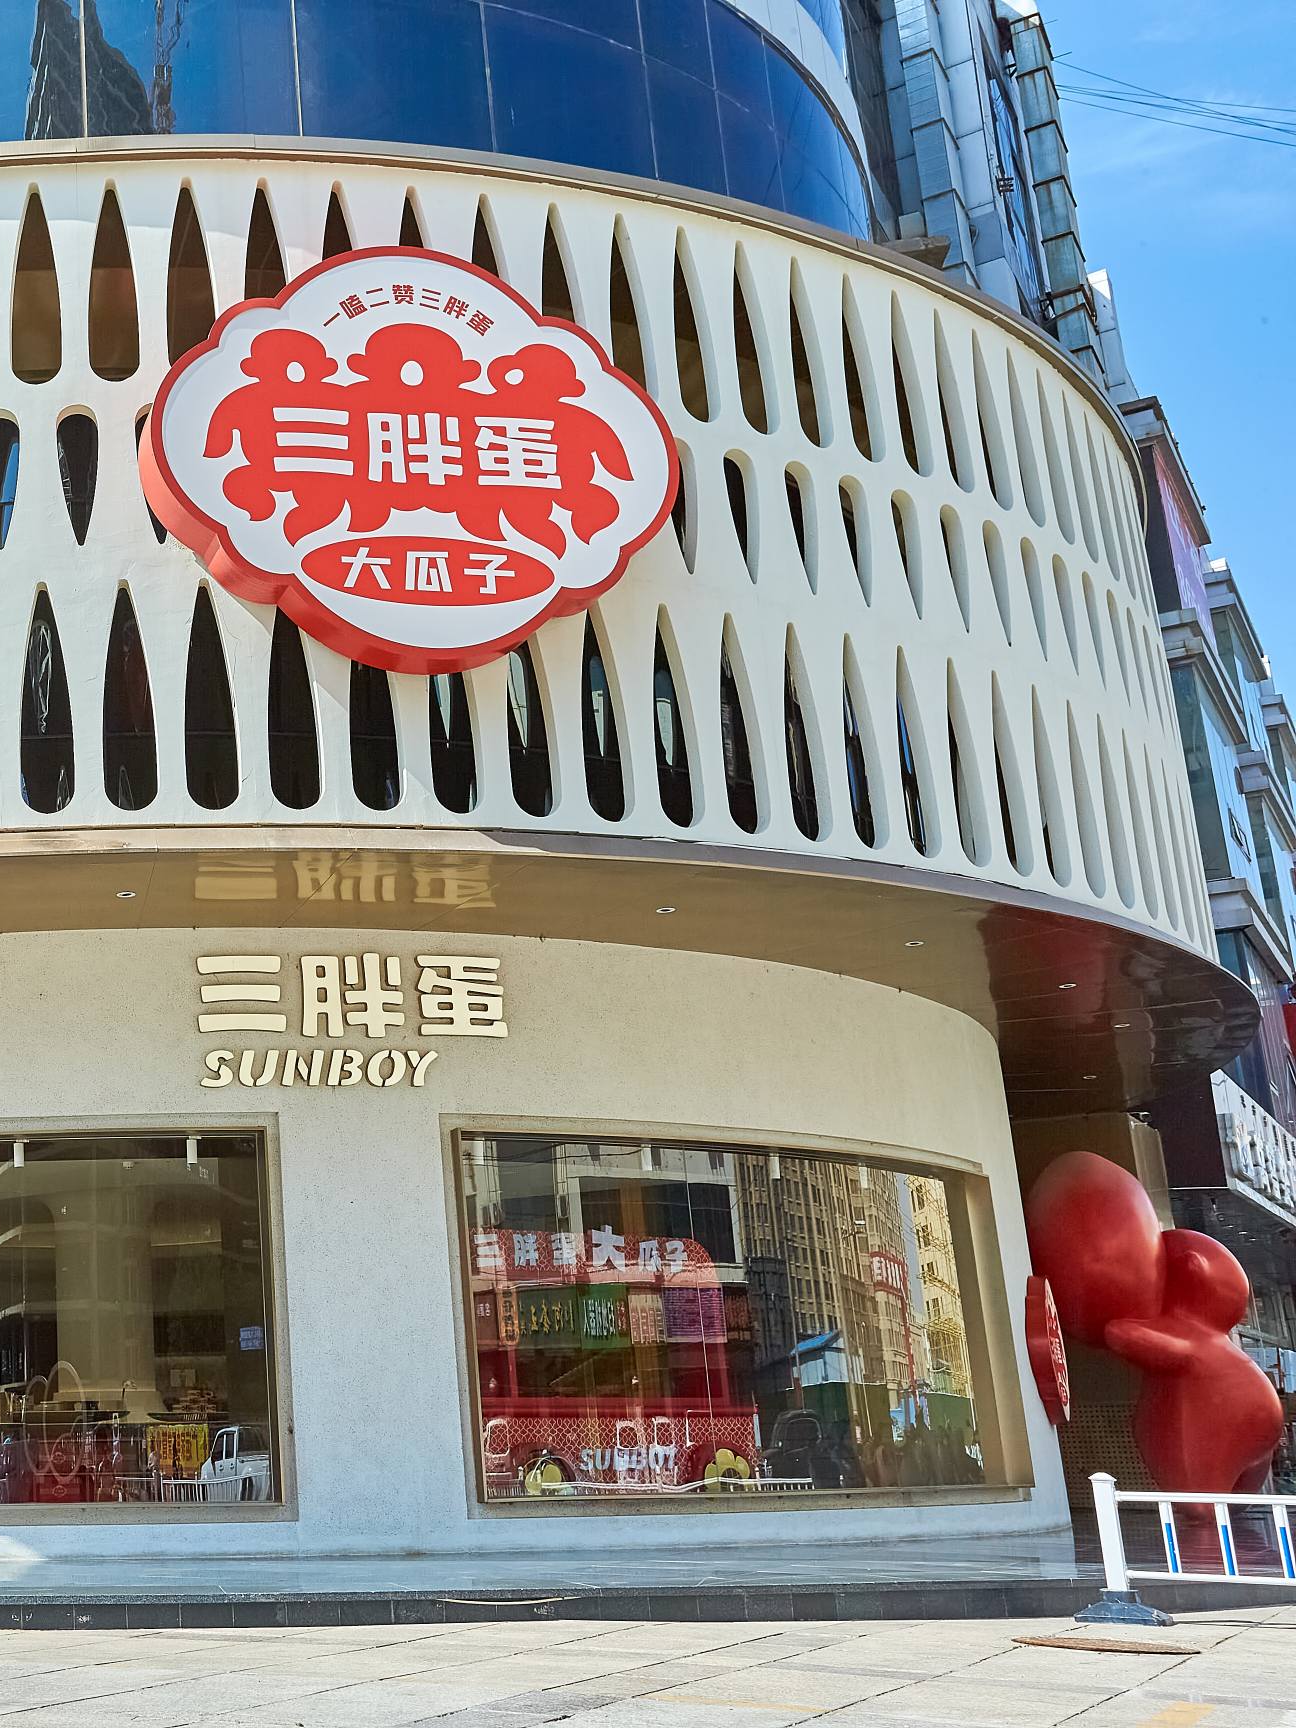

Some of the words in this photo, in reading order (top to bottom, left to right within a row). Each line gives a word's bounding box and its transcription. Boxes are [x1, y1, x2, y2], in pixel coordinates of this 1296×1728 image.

[323, 284, 495, 337] 一嗑二赞三胖蛋
[272, 406, 562, 490] 三胖蛋
[340, 546, 515, 595] 大瓜子
[197, 952, 508, 1038] 三胖蛋
[200, 1048, 439, 1088] SUNBOY
